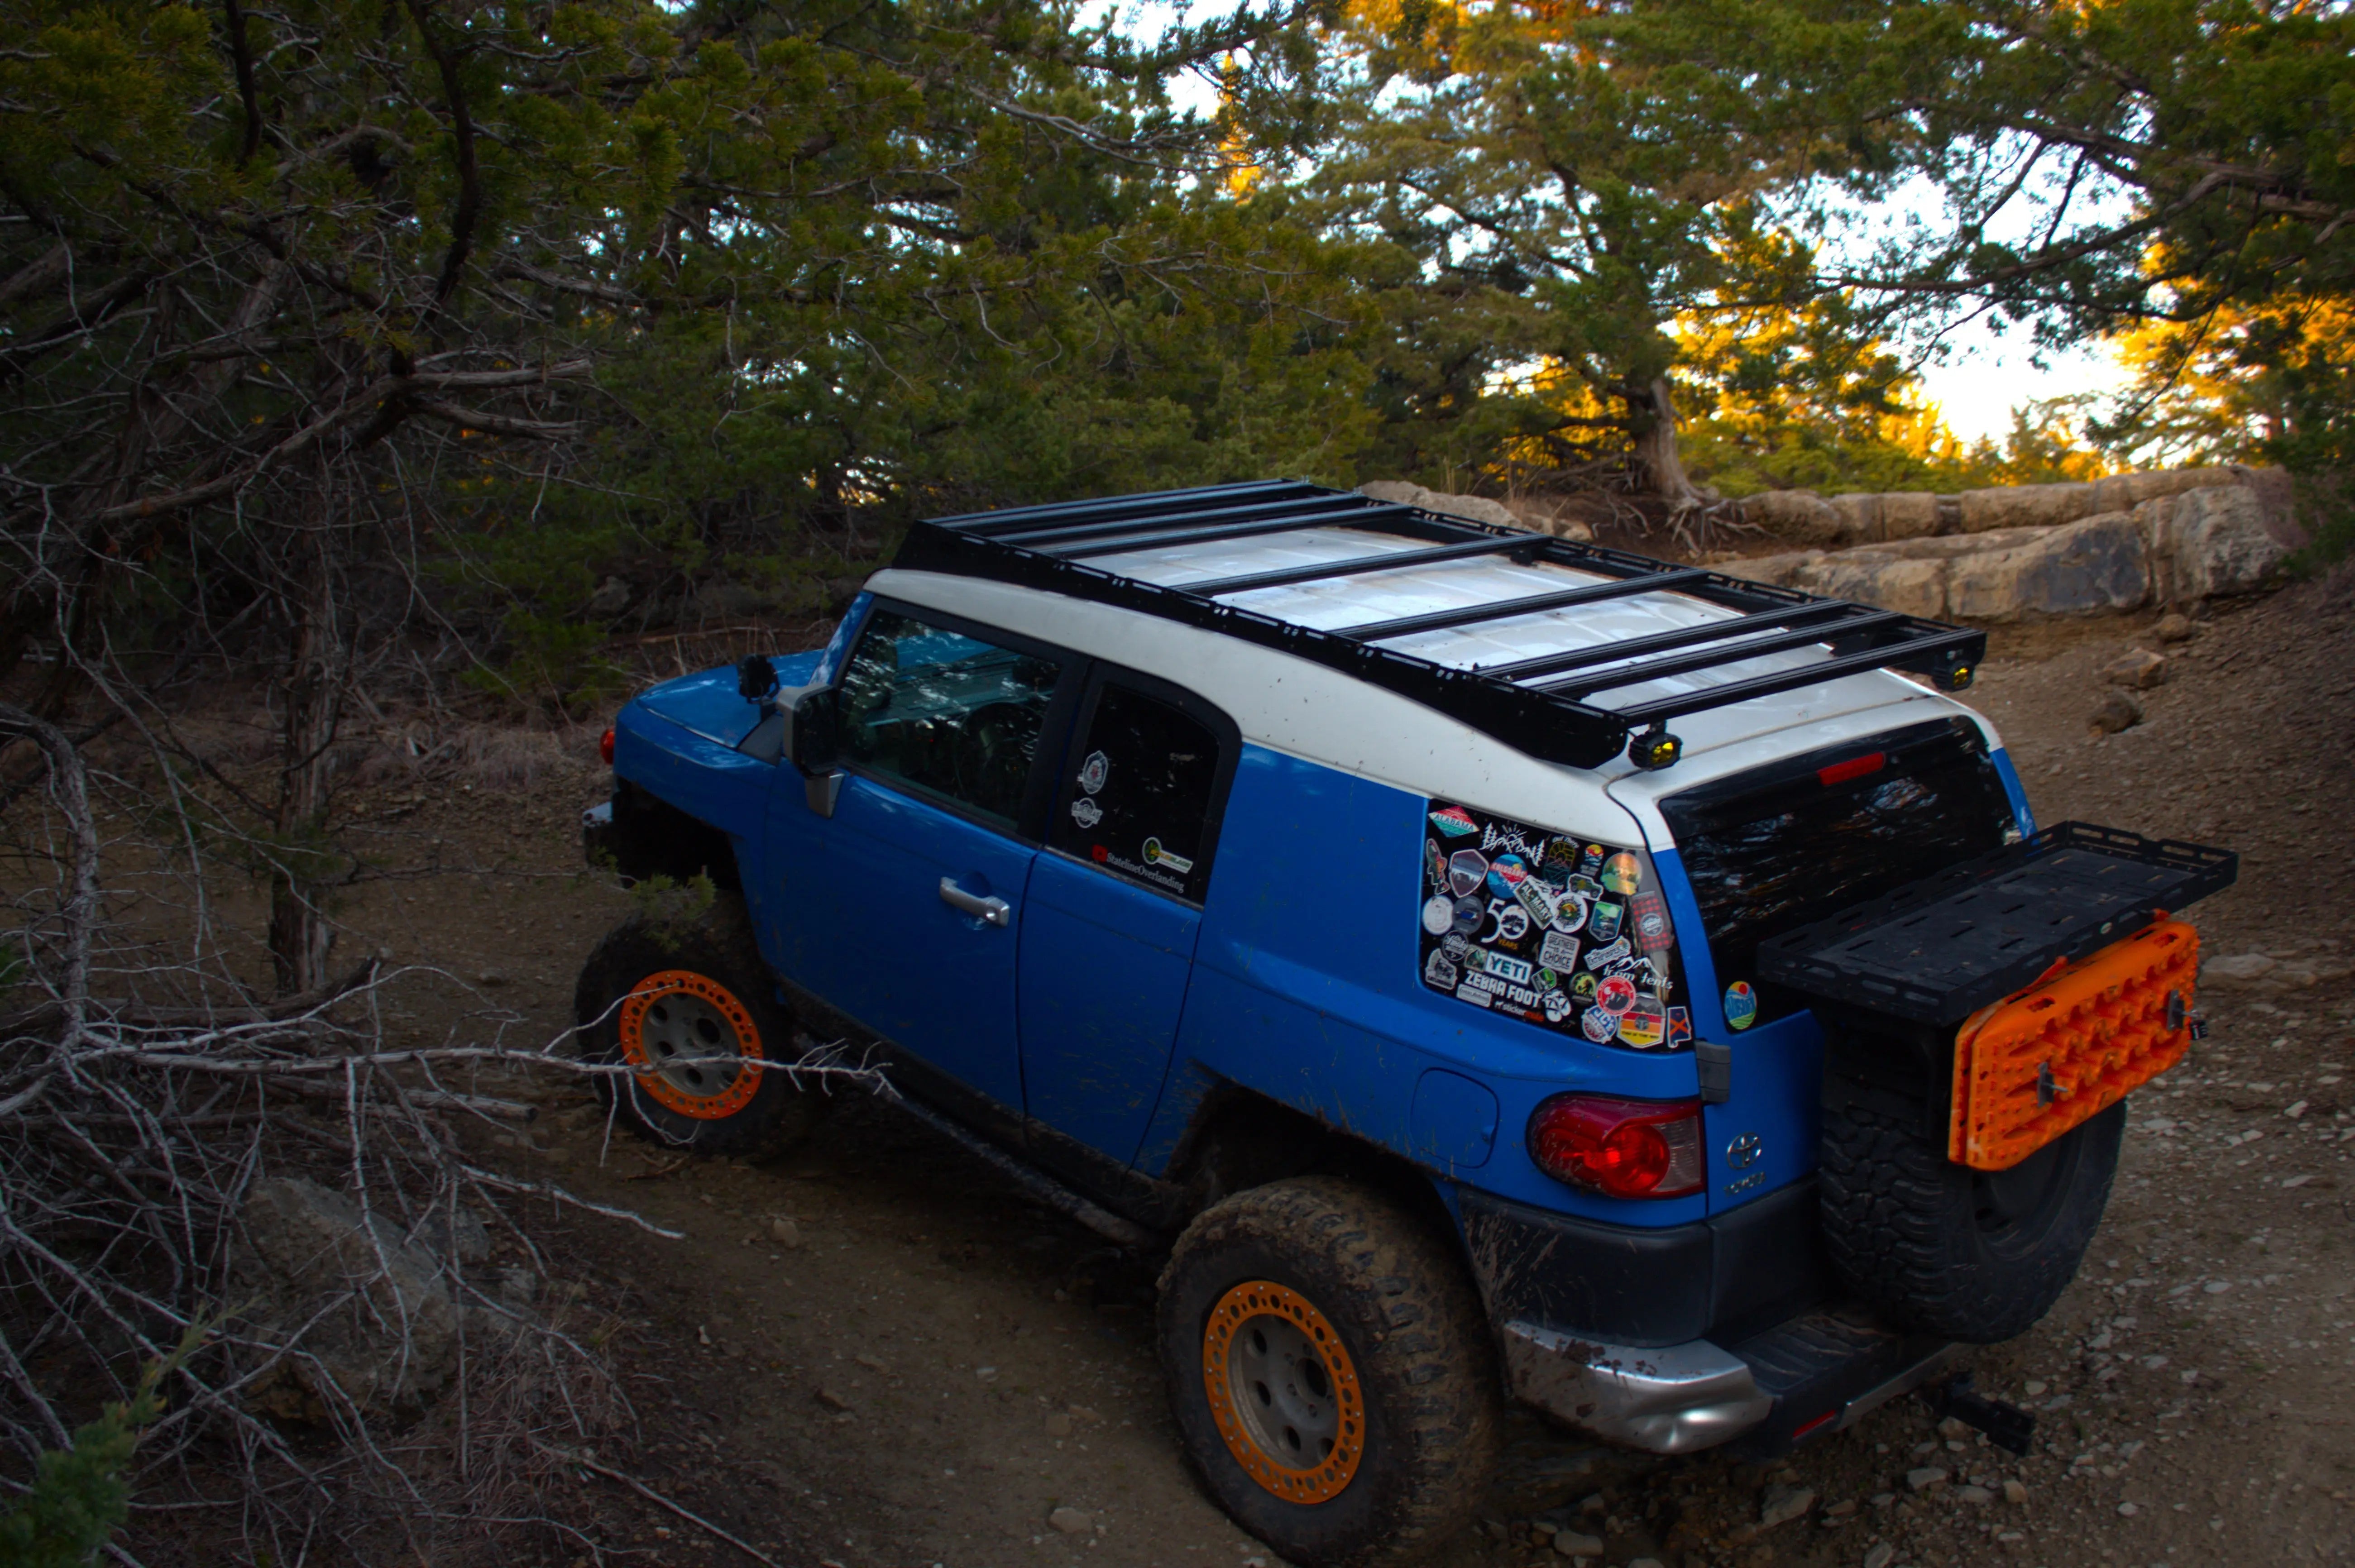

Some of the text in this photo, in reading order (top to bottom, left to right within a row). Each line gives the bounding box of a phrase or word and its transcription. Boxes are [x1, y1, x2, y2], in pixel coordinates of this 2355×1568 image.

[1434, 815, 1474, 832] ALABAMA
[1107, 853, 1184, 893] StatelineOverlanding
[1498, 939, 1518, 950] YEARS
[1491, 956, 1528, 980] YETI
[1543, 951, 1572, 970] CHOICE
[1464, 969, 1508, 997] ZEBRA
[1506, 984, 1543, 1008] FOOT
[1641, 972, 1674, 990] tents
[1724, 1171, 1766, 1195] TOYOTA
